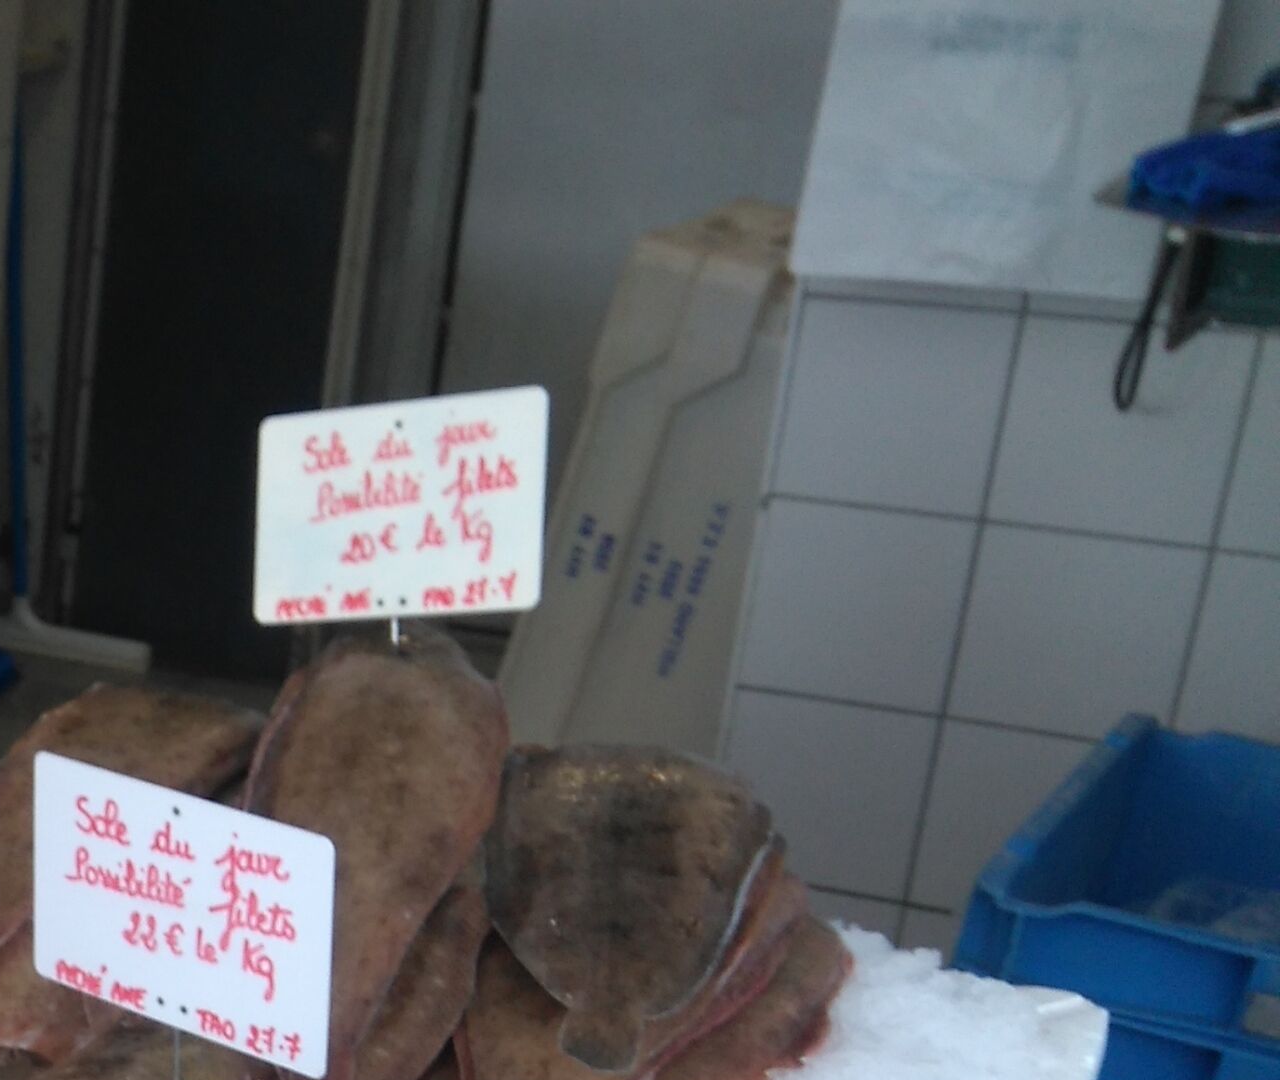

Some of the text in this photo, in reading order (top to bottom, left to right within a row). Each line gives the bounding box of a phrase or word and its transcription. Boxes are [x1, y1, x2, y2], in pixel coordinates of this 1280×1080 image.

[302, 430, 351, 475] Sole
[373, 432, 414, 462] du
[74, 796, 290, 898] Sole du jour
[208, 868, 297, 952] filets
[196, 927, 219, 964] le
[195, 1008, 236, 1041] FAO
